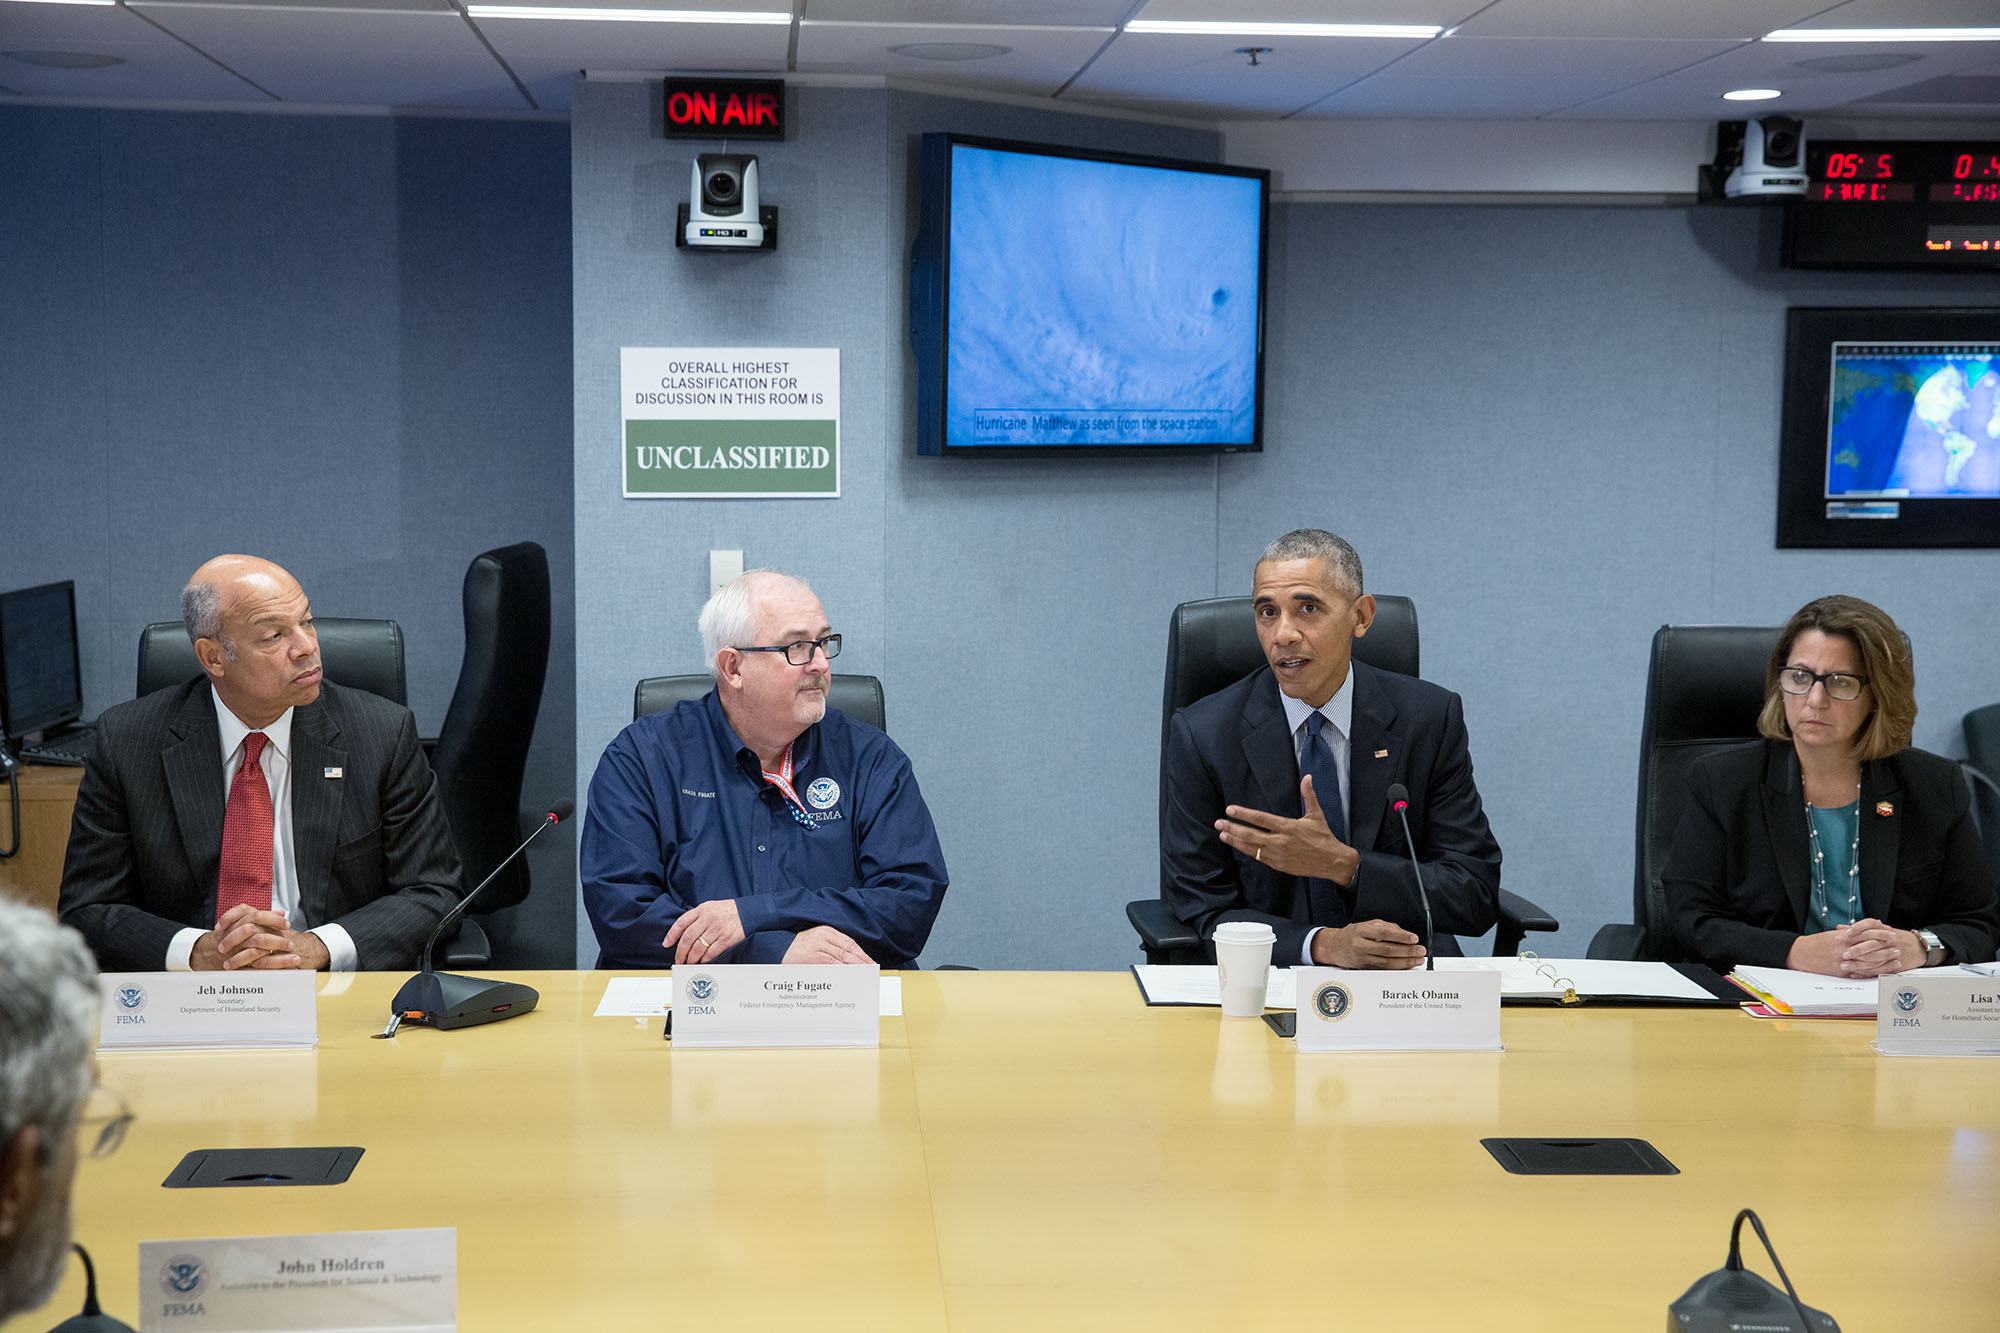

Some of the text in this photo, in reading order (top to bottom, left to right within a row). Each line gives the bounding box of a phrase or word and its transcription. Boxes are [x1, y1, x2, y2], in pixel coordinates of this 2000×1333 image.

[668, 91, 779, 126] ON AIR
[668, 361, 790, 374] OVERALL HIGHEST
[661, 377, 798, 389] CLASSIFICATION FOR
[635, 392, 824, 405] DISCUSSION IN THIS ROOM IS
[976, 416, 1218, 432] Hurricane Matthew as seen from the space station
[635, 446, 830, 469] UNCLASSIFIED
[808, 810, 841, 821] FEMA
[197, 985, 264, 995] Jeh Johnson
[764, 980, 832, 992] Craig Fugate
[1381, 990, 1459, 1000] Barack Obama
[1971, 994, 1993, 1003] Lisa
[216, 998, 245, 1006] Secretary
[224, 1005, 256, 1013] Homeland
[257, 1005, 281, 1014] Security
[687, 1006, 716, 1015] FEMA
[116, 1015, 146, 1024] FEMA
[1893, 1018, 1921, 1027] FEMA
[276, 1258, 385, 1275] John Holdren
[162, 1303, 207, 1317] FEMA
